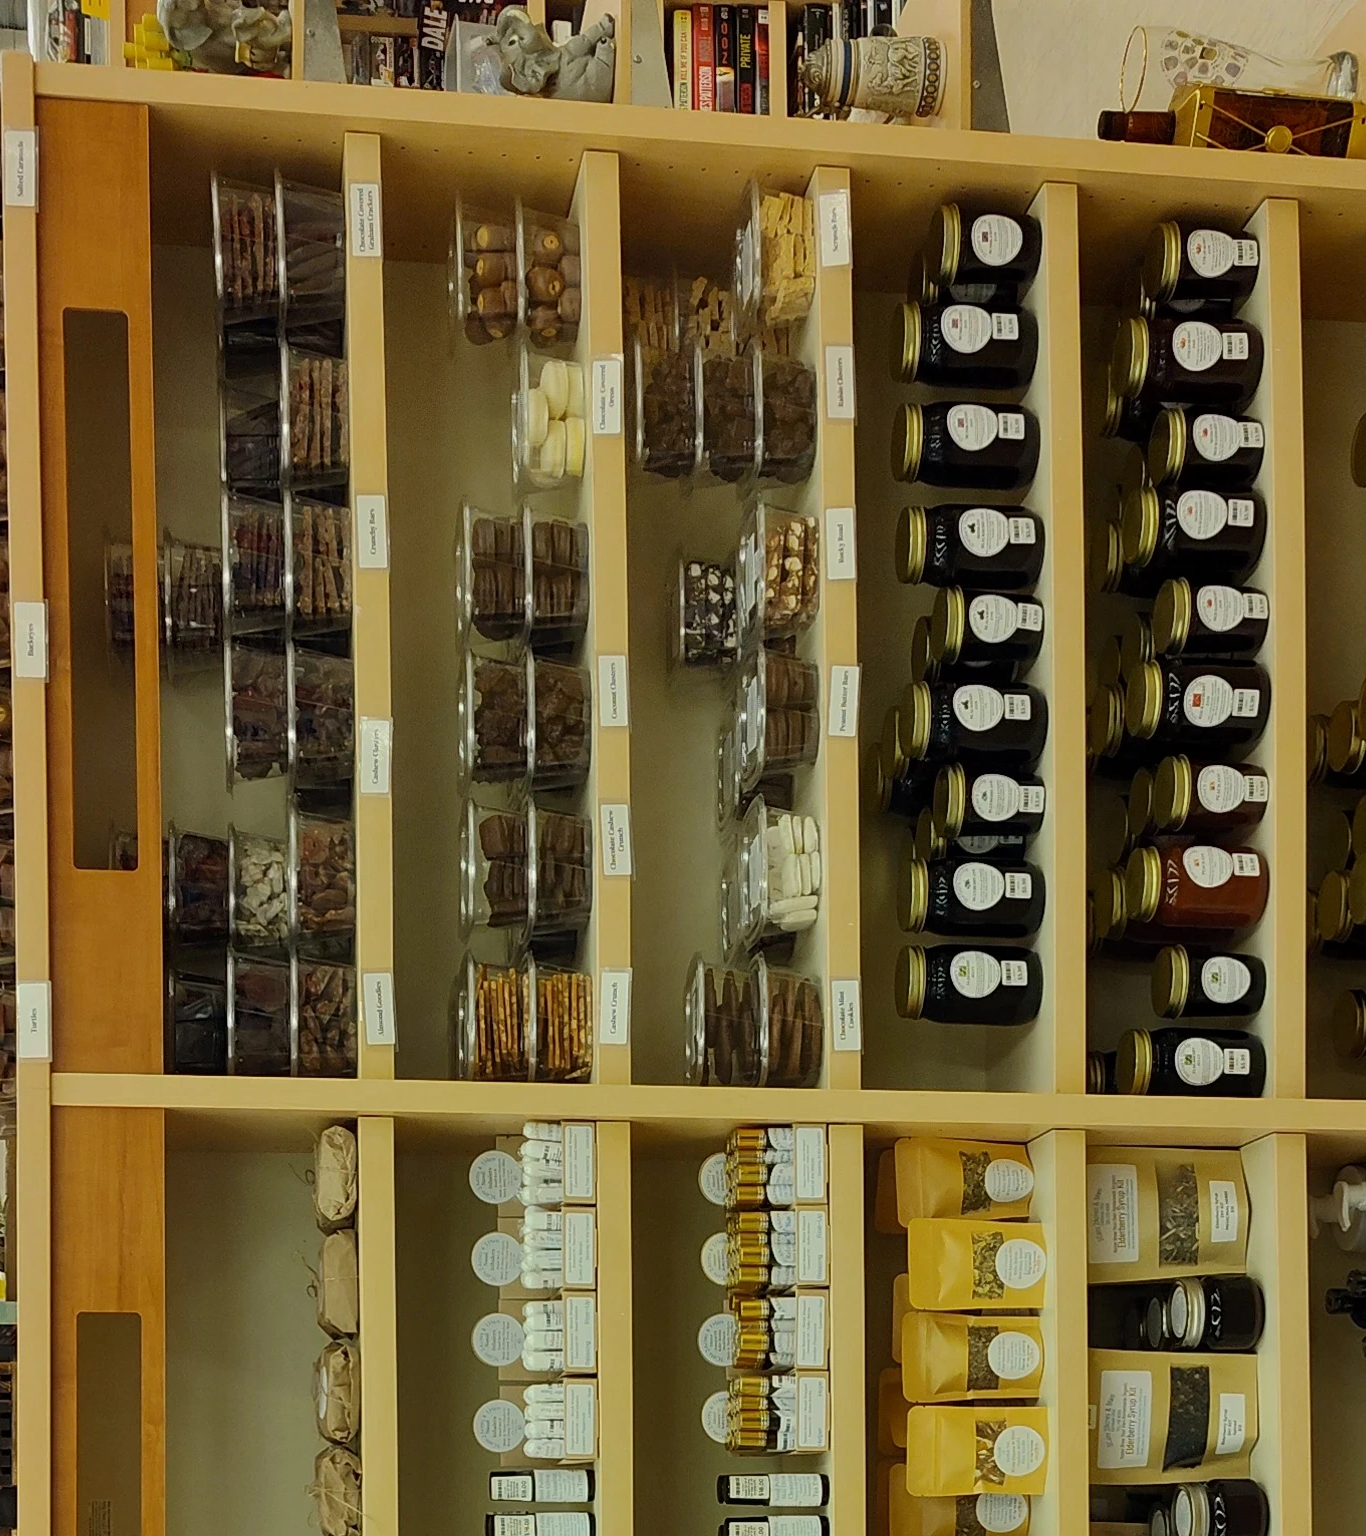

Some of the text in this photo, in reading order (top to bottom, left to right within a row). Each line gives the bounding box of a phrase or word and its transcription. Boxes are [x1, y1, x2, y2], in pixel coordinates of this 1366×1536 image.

[421, 6, 448, 51] DALE
[740, 34, 751, 68] PRIVATE
[357, 188, 365, 252] Chocolate Covered
[367, 223, 375, 250] Graham
[370, 527, 378, 555] Crunchy
[27, 623, 36, 656] Buckeyes
[609, 837, 617, 870] Chocolate
[617, 828, 625, 852] Crunch
[30, 1008, 38, 1033] Turtles
[839, 1007, 847, 1040] Chocolate
[1116, 1179, 1126, 1248] Elderberry Syrup Kit
[1125, 1387, 1137, 1455] Elderberry Syrup Kit
